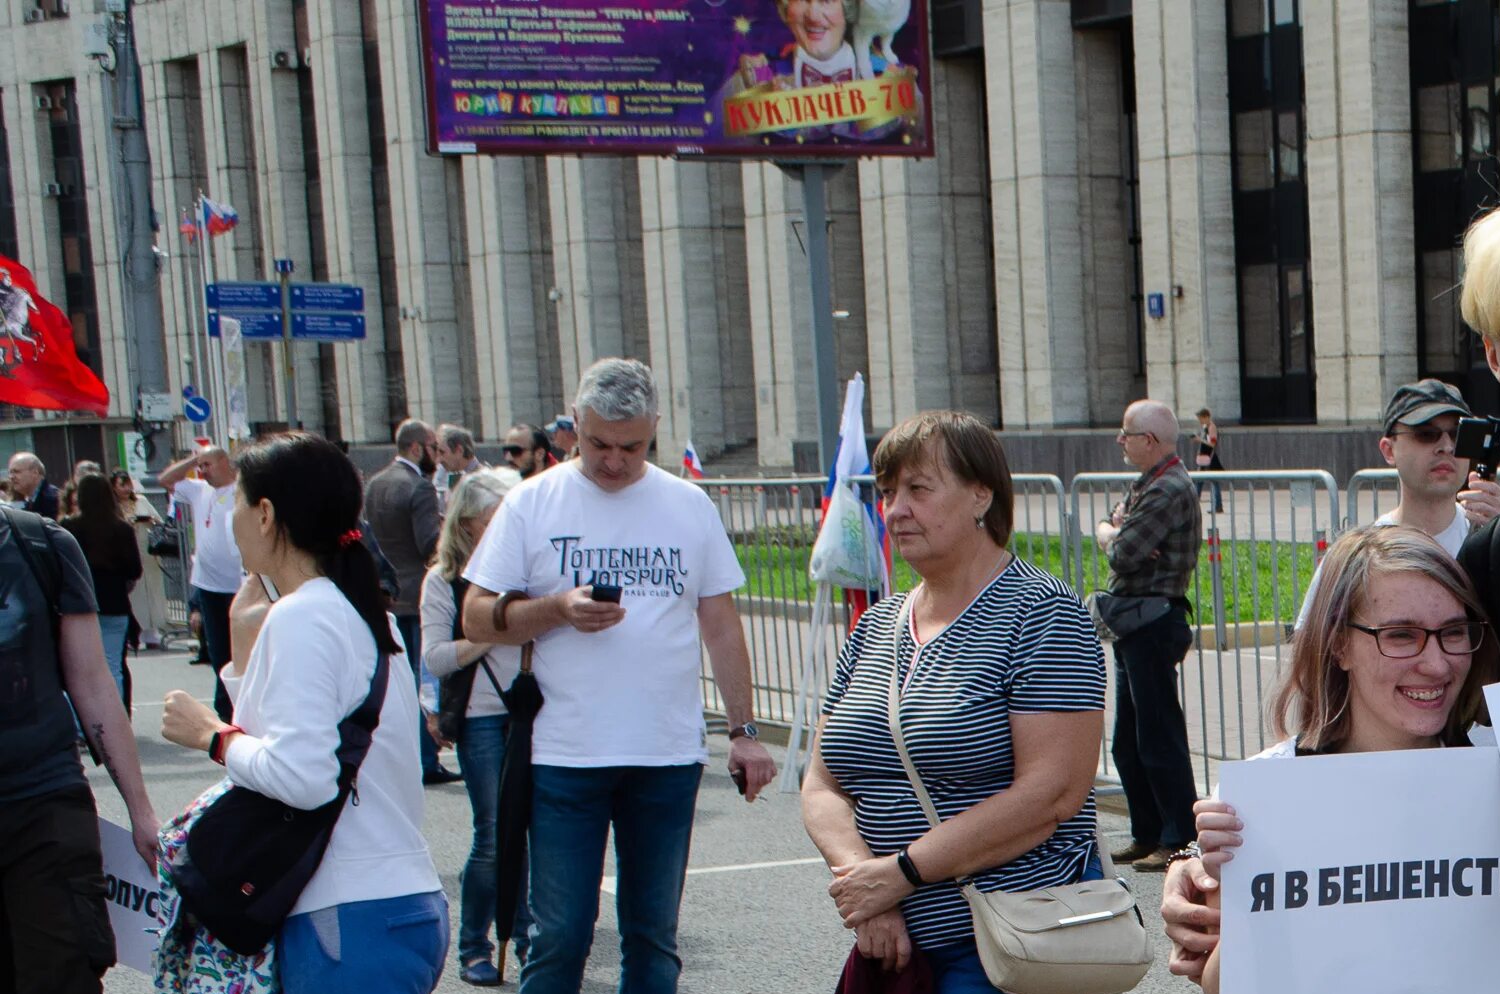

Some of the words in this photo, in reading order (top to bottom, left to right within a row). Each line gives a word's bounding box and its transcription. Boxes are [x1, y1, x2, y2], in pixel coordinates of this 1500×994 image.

[455, 94, 513, 115] ЮРИЙ
[104, 873, 159, 919] ОПУС
[1250, 872, 1275, 912] Я
[1285, 870, 1309, 909] В
